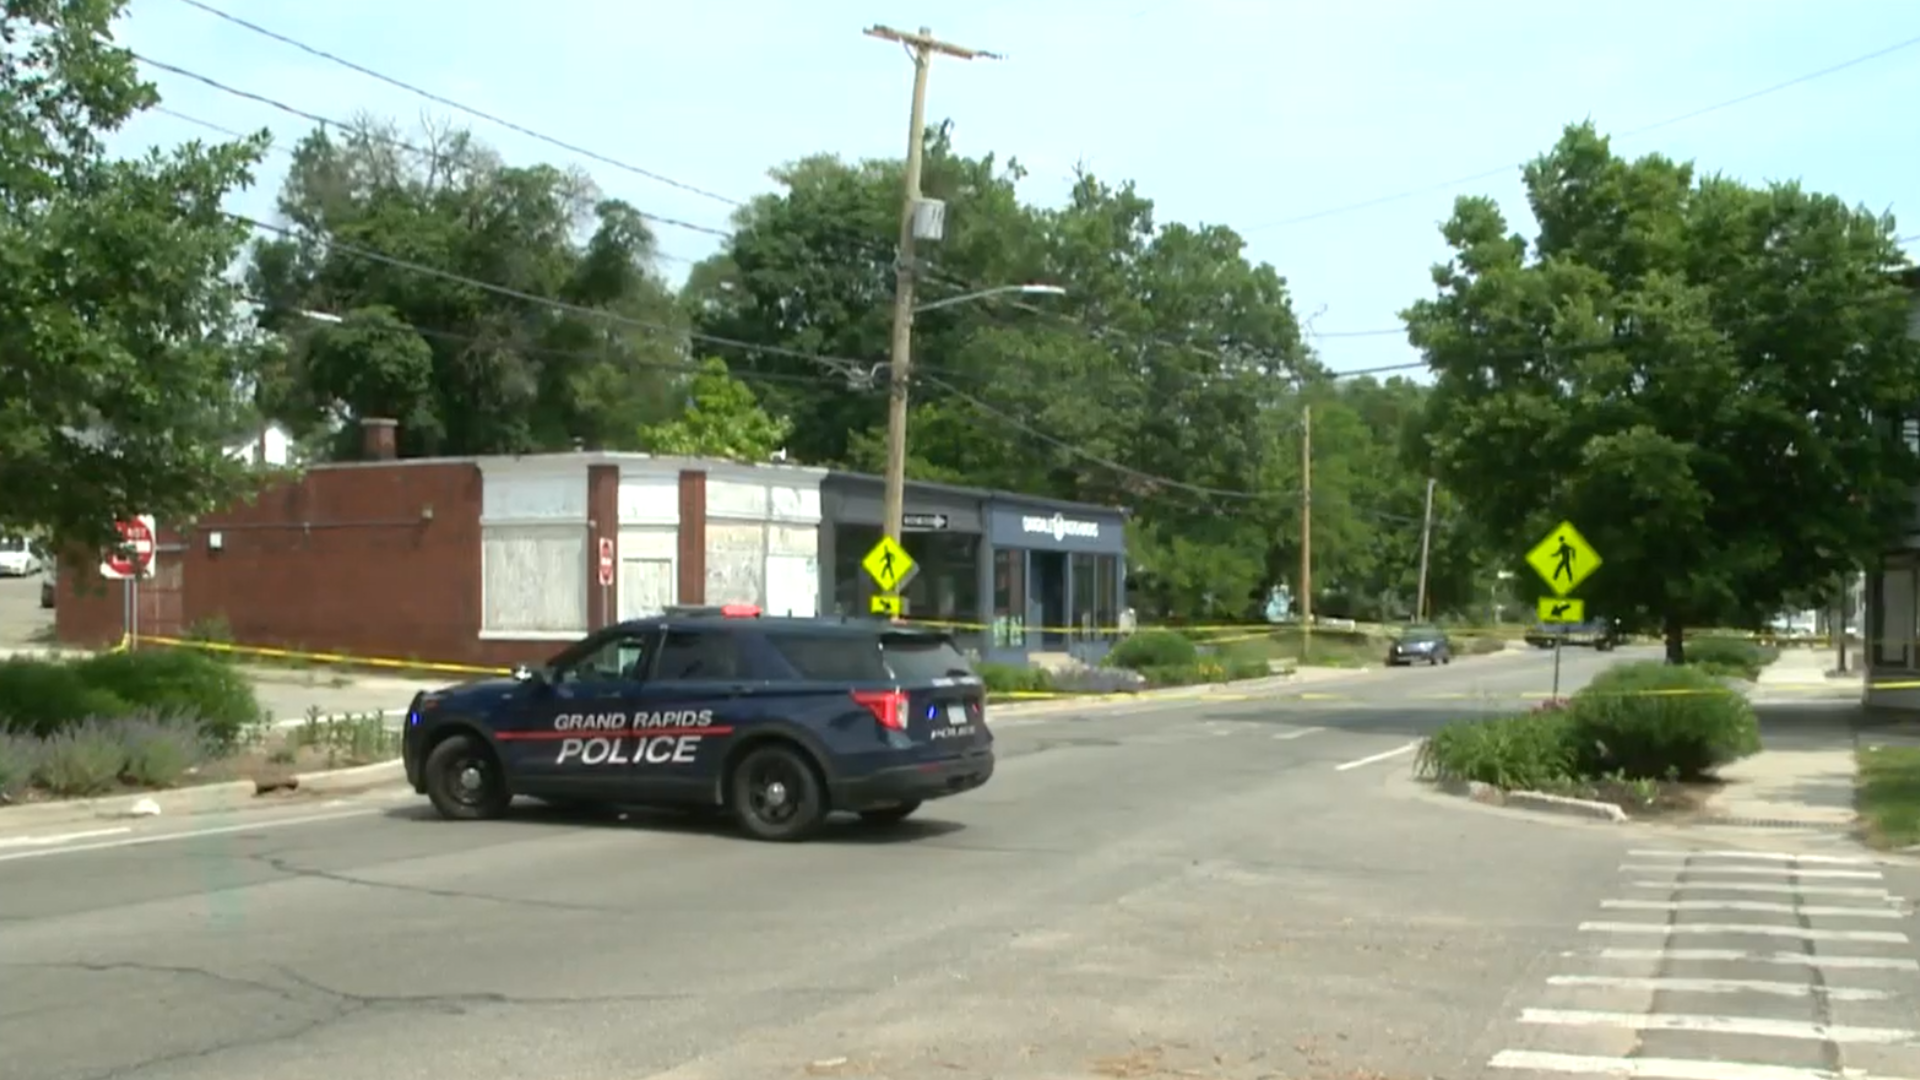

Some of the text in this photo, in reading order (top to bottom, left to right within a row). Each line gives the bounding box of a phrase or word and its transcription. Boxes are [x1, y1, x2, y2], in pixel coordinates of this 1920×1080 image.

[554, 710, 713, 730] GRAND RAPIDS
[555, 735, 702, 764] POLICE
